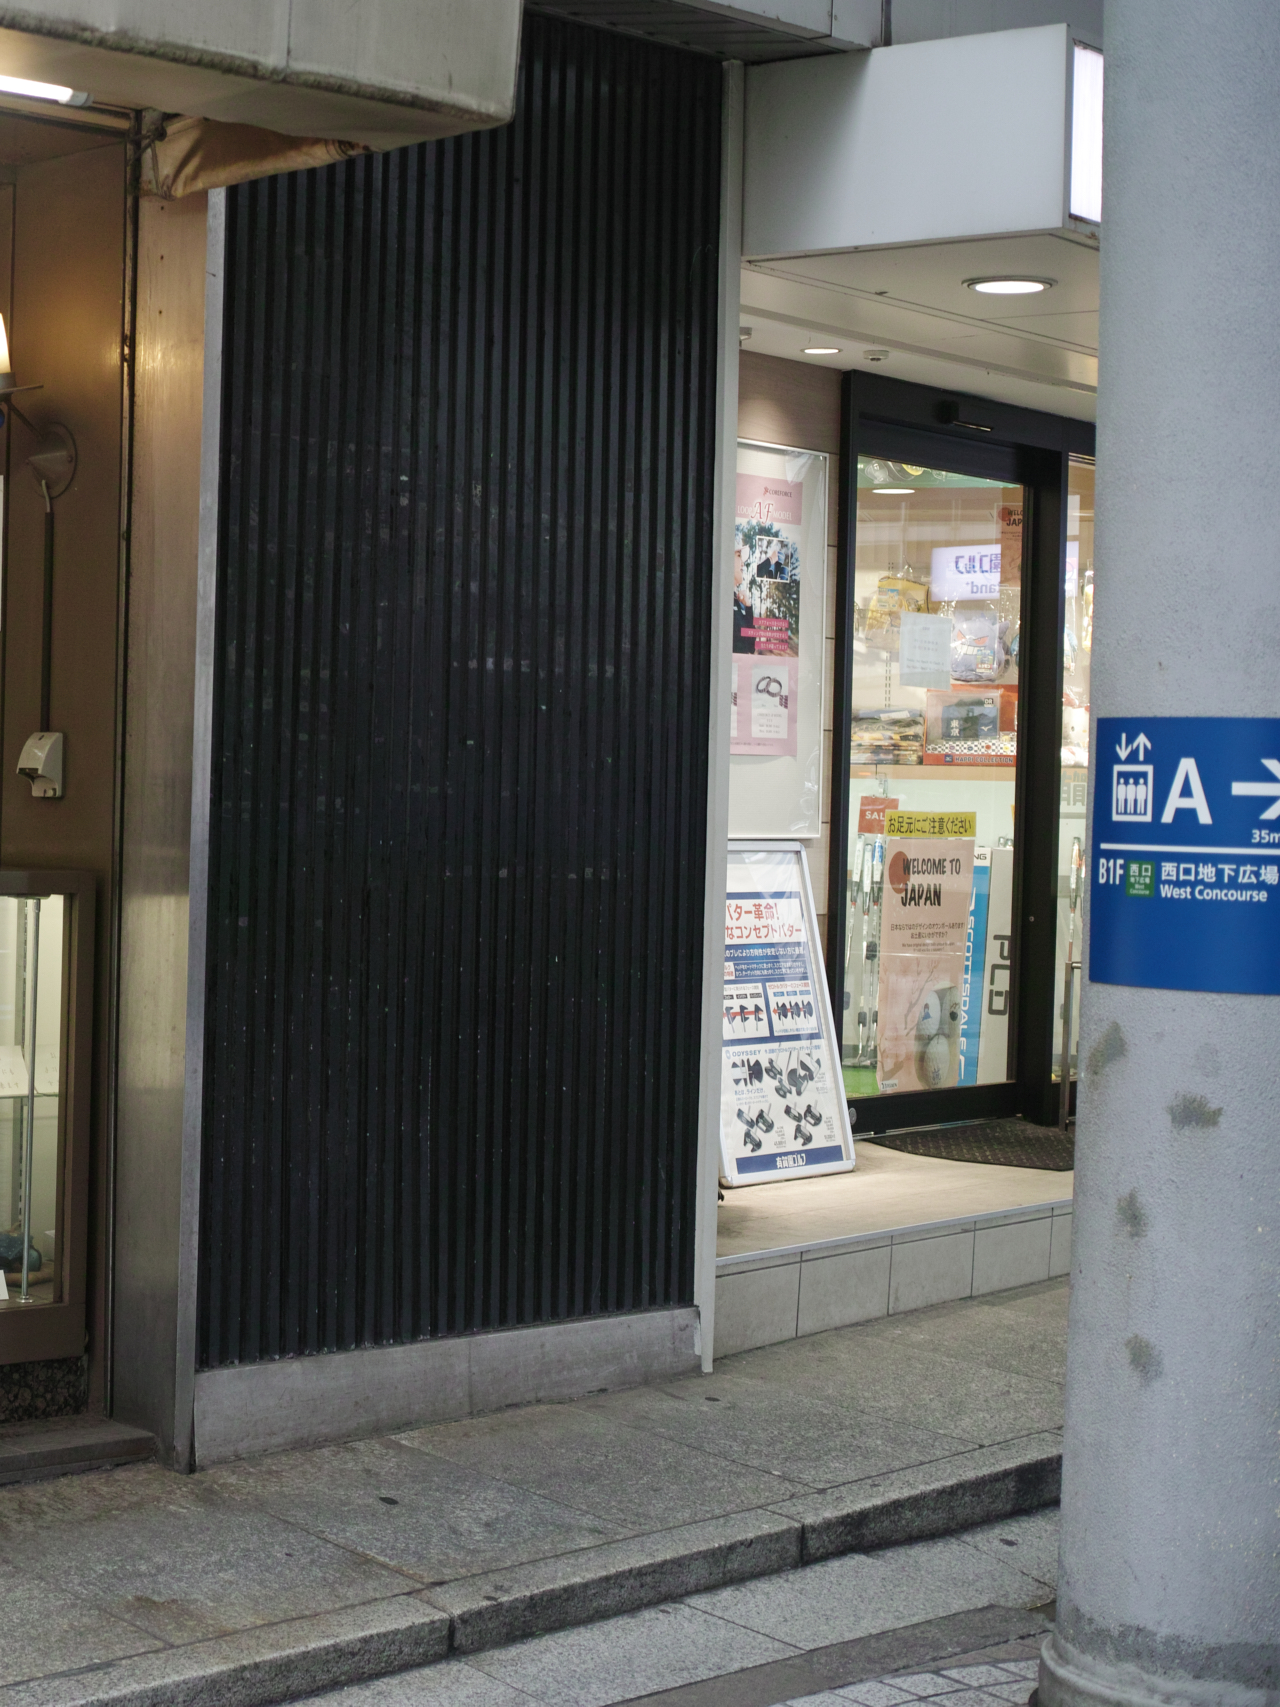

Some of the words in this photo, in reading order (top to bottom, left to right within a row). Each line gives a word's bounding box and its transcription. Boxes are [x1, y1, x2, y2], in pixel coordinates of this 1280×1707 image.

[772, 509, 793, 521] MODEL
[976, 756, 1013, 764] COLLECTION
[1160, 757, 1213, 824] A
[887, 815, 972, 834] お足元にご注意ください
[1251, 829, 1280, 843] 35m
[902, 858, 947, 875] WELCOME
[949, 858, 961, 875] TO
[1098, 858, 1125, 885] B1F
[1129, 864, 1152, 876] 西口
[1161, 862, 1279, 885] 西口地下広場
[901, 883, 942, 907] JAPAN
[1160, 884, 1192, 899] West
[1194, 886, 1268, 902] Concourse
[732, 1049, 761, 1057] ODYSSEY
